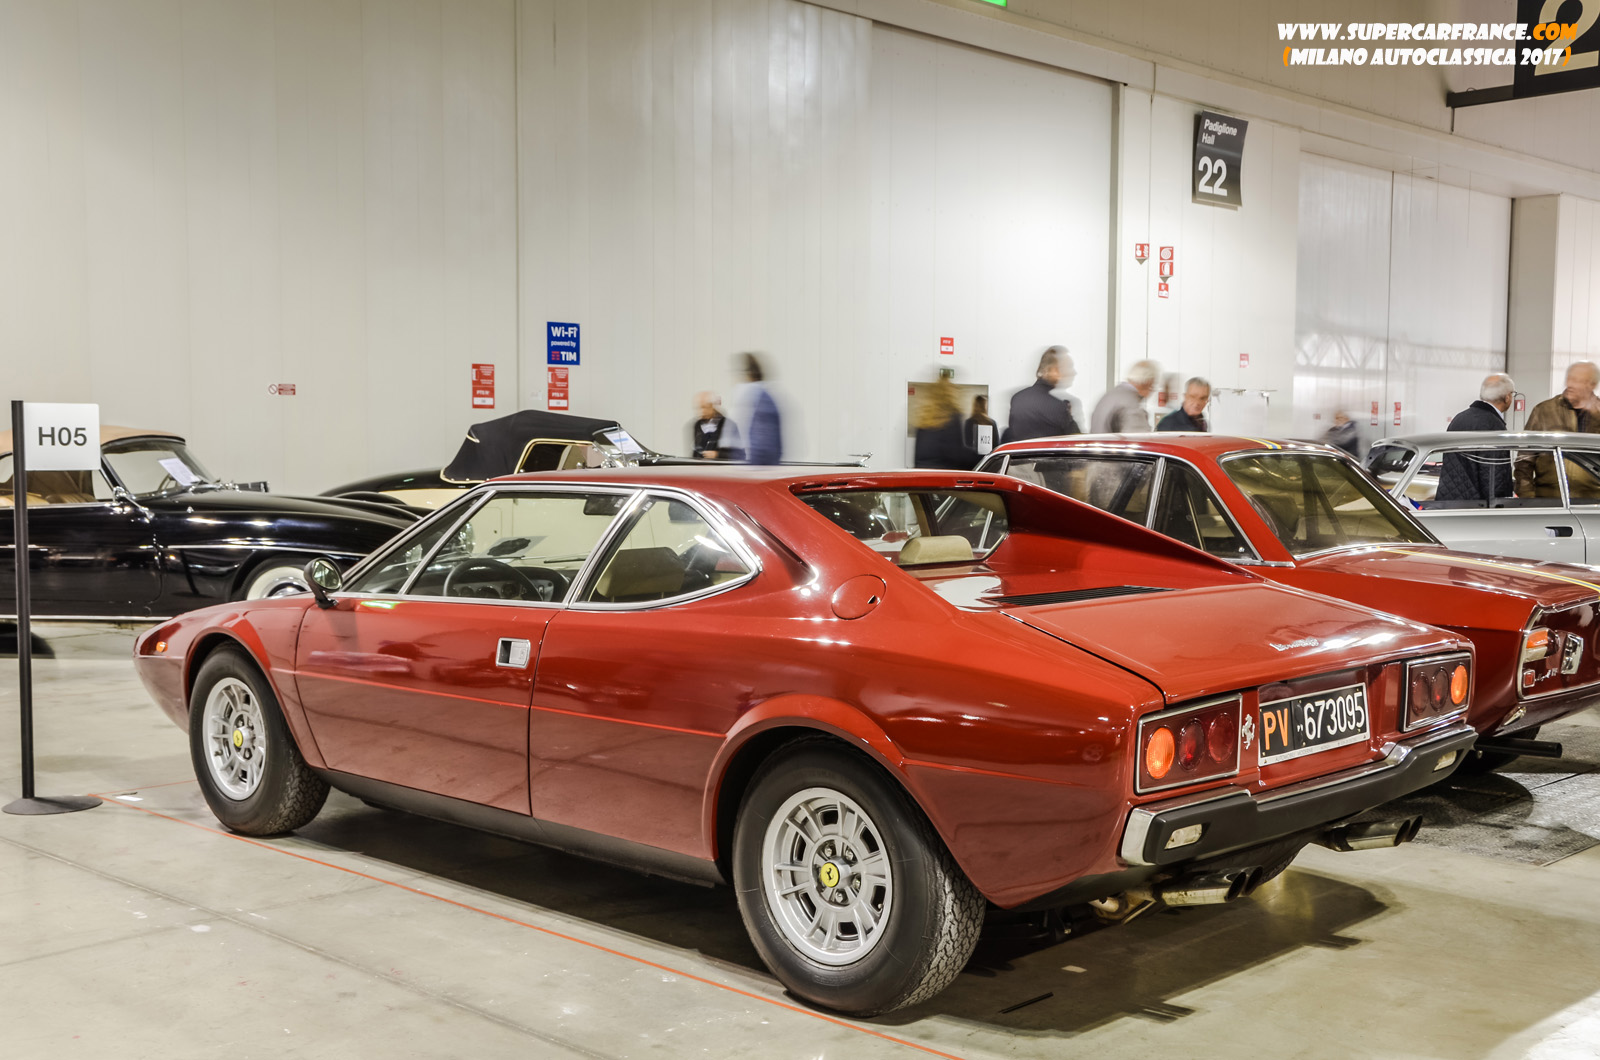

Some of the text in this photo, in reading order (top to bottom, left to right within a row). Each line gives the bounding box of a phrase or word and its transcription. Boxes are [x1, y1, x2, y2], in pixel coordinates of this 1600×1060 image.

[1204, 118, 1238, 136] Padiglione
[1201, 132, 1216, 145] Hall
[1198, 155, 1228, 197] 22
[550, 326, 578, 338] Wi-Fi
[560, 351, 577, 361] TIM
[38, 426, 88, 447] H05
[1262, 707, 1289, 751] PV
[1303, 691, 1365, 740] 673095
